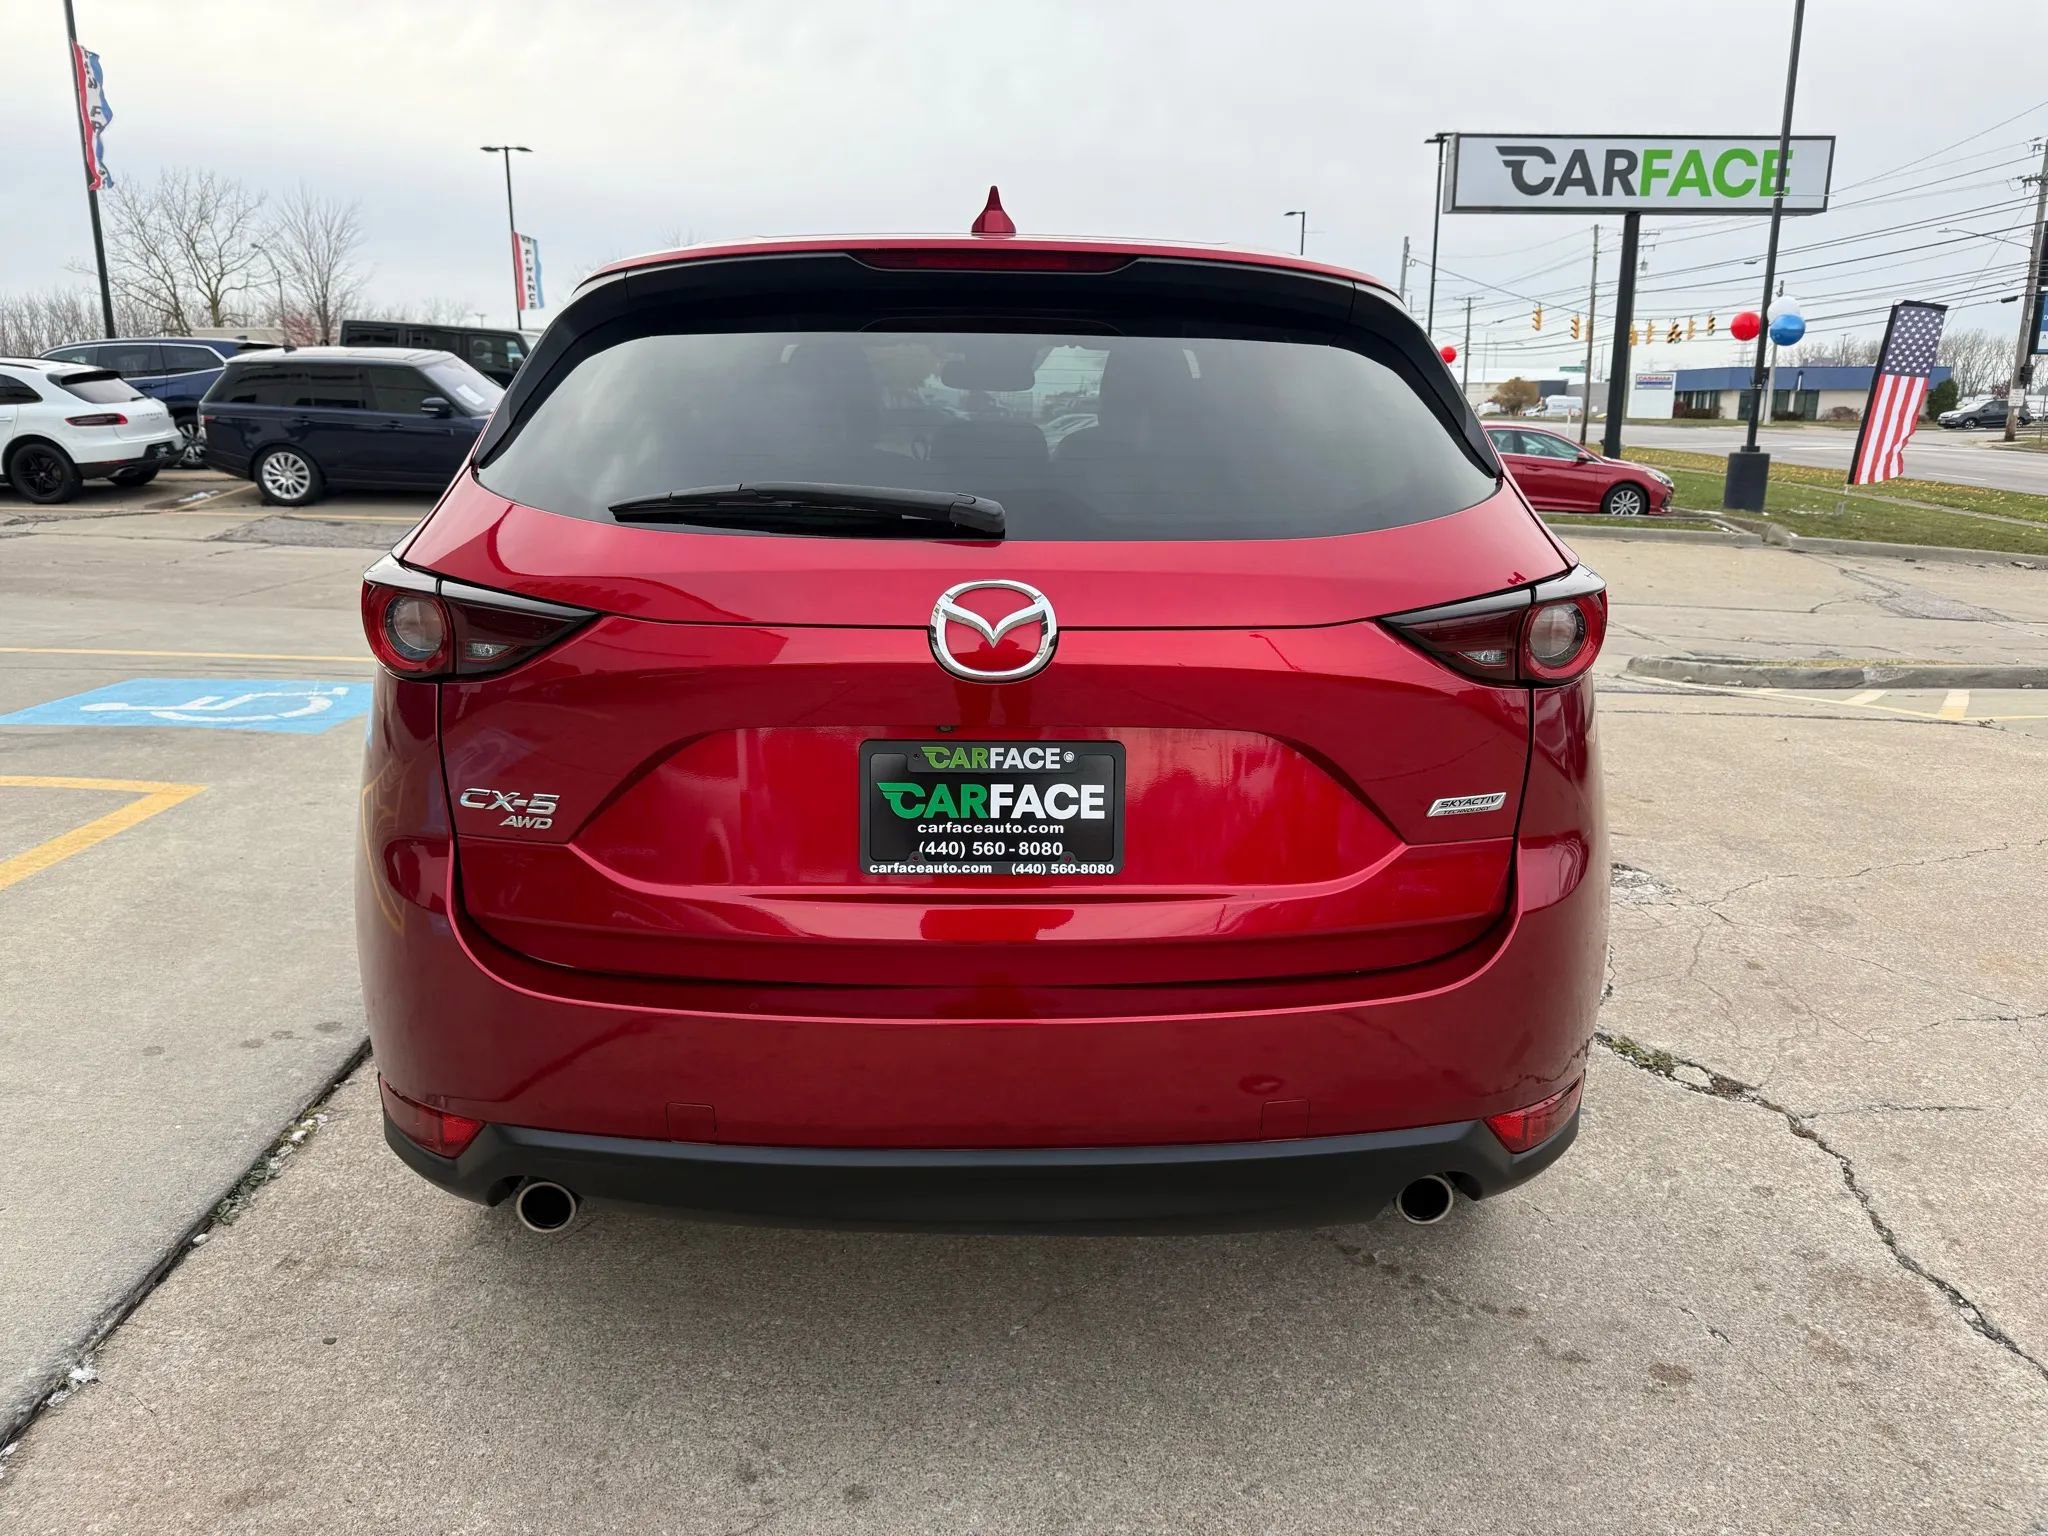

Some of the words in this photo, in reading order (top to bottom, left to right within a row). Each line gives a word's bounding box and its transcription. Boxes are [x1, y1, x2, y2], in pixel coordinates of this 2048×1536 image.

[1495, 145, 1794, 199] CARFACE
[920, 746, 1061, 770] CARFACE
[460, 788, 560, 815] CX-5
[876, 782, 1105, 820] CARFACE
[1440, 795, 1500, 808] SKYACTIV
[499, 815, 553, 830] AWD
[917, 821, 1064, 834] carfaceauto.com
[918, 841, 966, 858] (440)
[869, 862, 993, 874] carfaceauto.com
[1011, 863, 1047, 876] (440)
[1050, 863, 1115, 875] 560-8080
